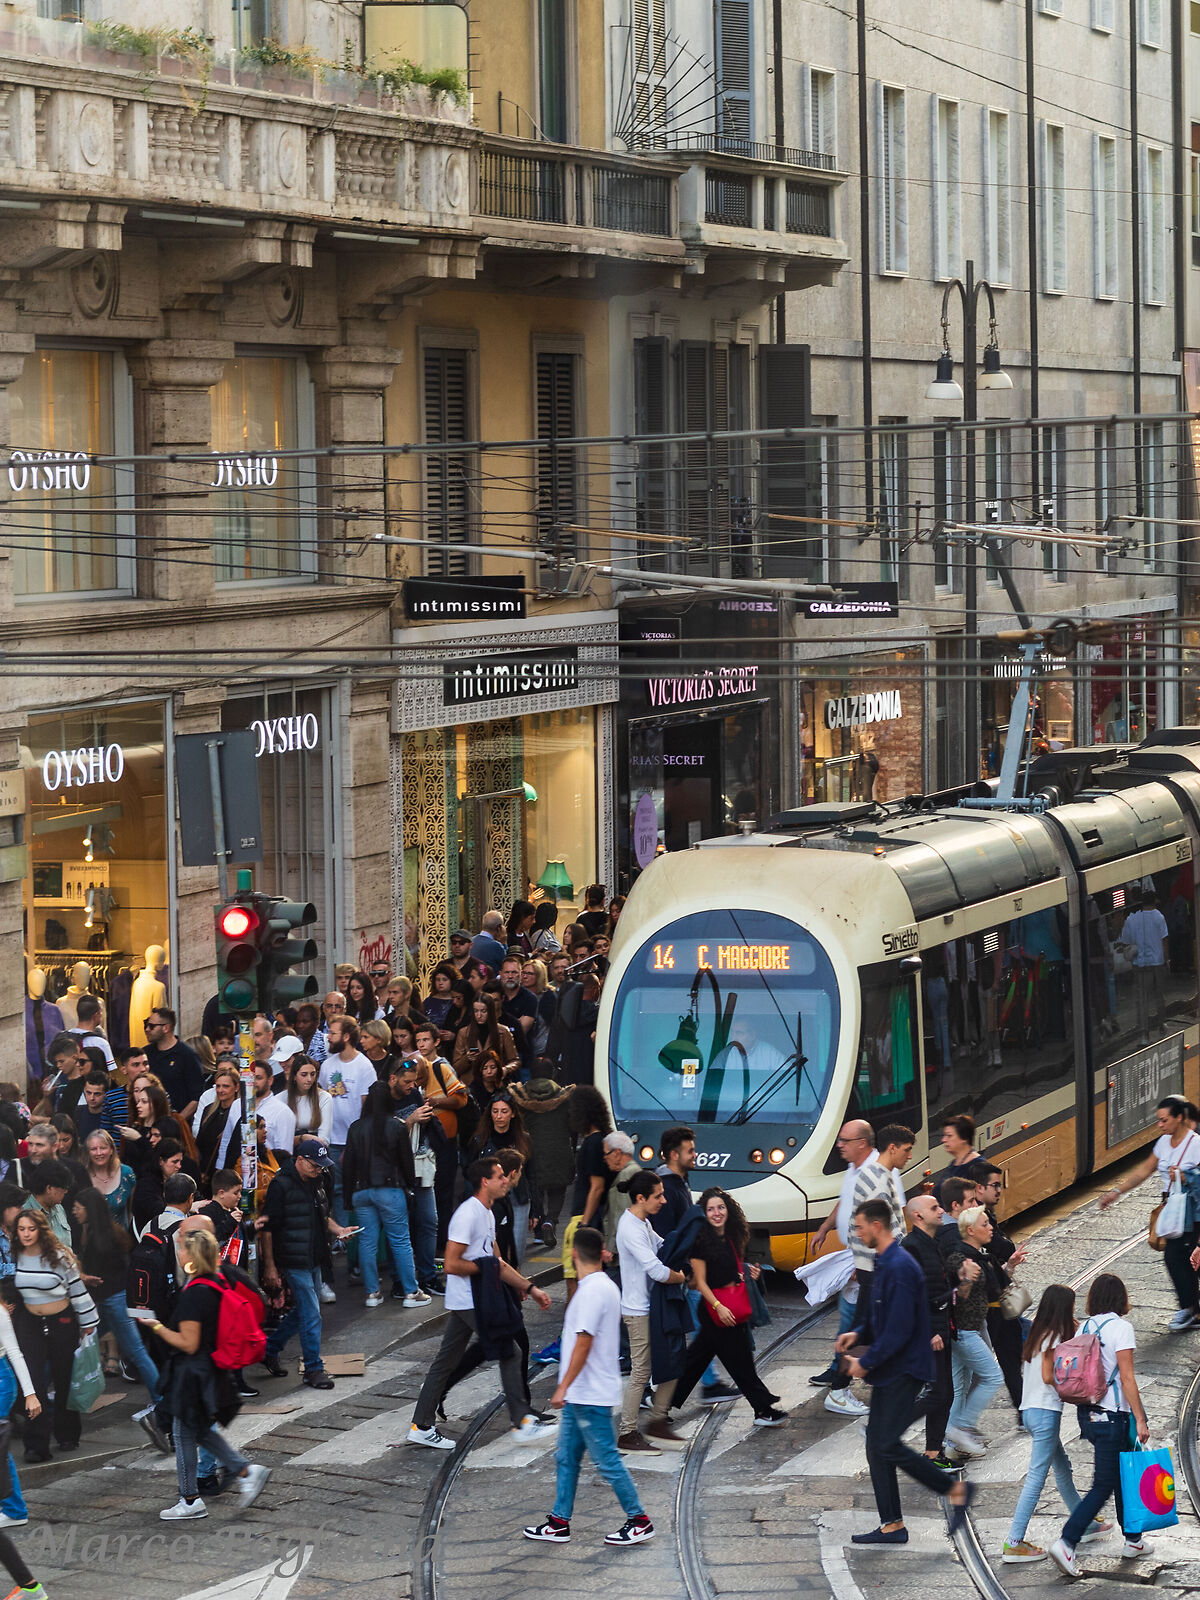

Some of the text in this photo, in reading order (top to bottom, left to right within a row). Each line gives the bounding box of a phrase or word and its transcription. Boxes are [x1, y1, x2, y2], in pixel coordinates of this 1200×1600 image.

[8, 451, 91, 491] OYSHO
[413, 600, 521, 612] intimissimi
[809, 601, 892, 613] CALZEDONIA
[641, 631, 676, 639] VICTORIA'S
[454, 658, 576, 699] intimissimi
[649, 664, 759, 707] VICTORIA'S SECRET
[826, 689, 902, 730] CALZEDONIA
[43, 743, 125, 791] OYSHO
[663, 754, 705, 766] SECRET
[652, 944, 790, 970] 14 C. MAGGIORE
[687, 1065, 693, 1074] 9
[695, 1152, 731, 1168] 627
